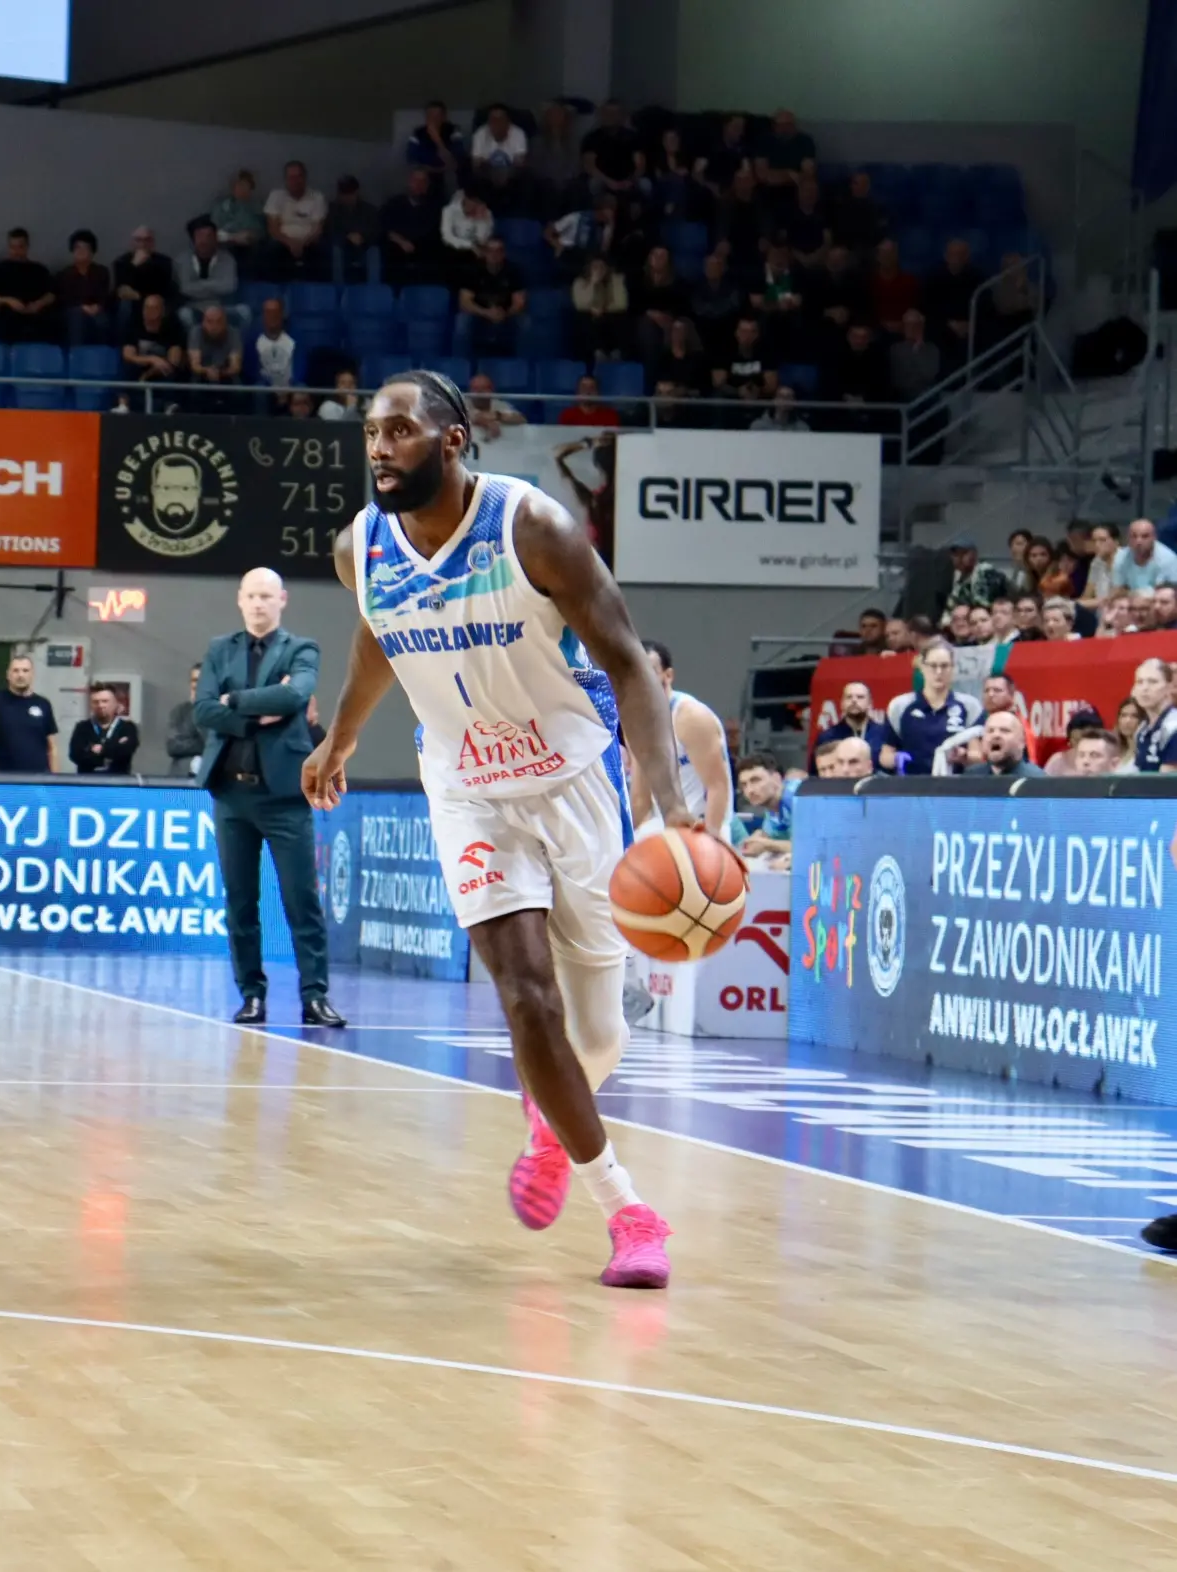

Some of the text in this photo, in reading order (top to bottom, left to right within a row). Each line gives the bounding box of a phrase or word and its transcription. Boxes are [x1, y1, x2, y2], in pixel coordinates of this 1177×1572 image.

[114, 430, 239, 503] UBEZPIECZENIA
[280, 437, 346, 468] 781
[279, 482, 345, 513] 715
[640, 475, 857, 525] GIRDER
[759, 553, 859, 569] www.girder.pl
[377, 621, 525, 659] WŁOCŁAWEK
[454, 672, 473, 707] 1
[456, 719, 549, 770] Anwil
[462, 754, 565, 787] GRUPA ORLEN
[459, 870, 505, 895] ORLEN
[931, 817, 1164, 910] PRZEŻYJ DZIEŃ
[802, 904, 857, 988] Sport
[929, 915, 1162, 998] Z ZAWODNIKAMI
[719, 985, 788, 1012] ORL
[928, 991, 1159, 1069] ANWILU WŁOCŁAWEK
